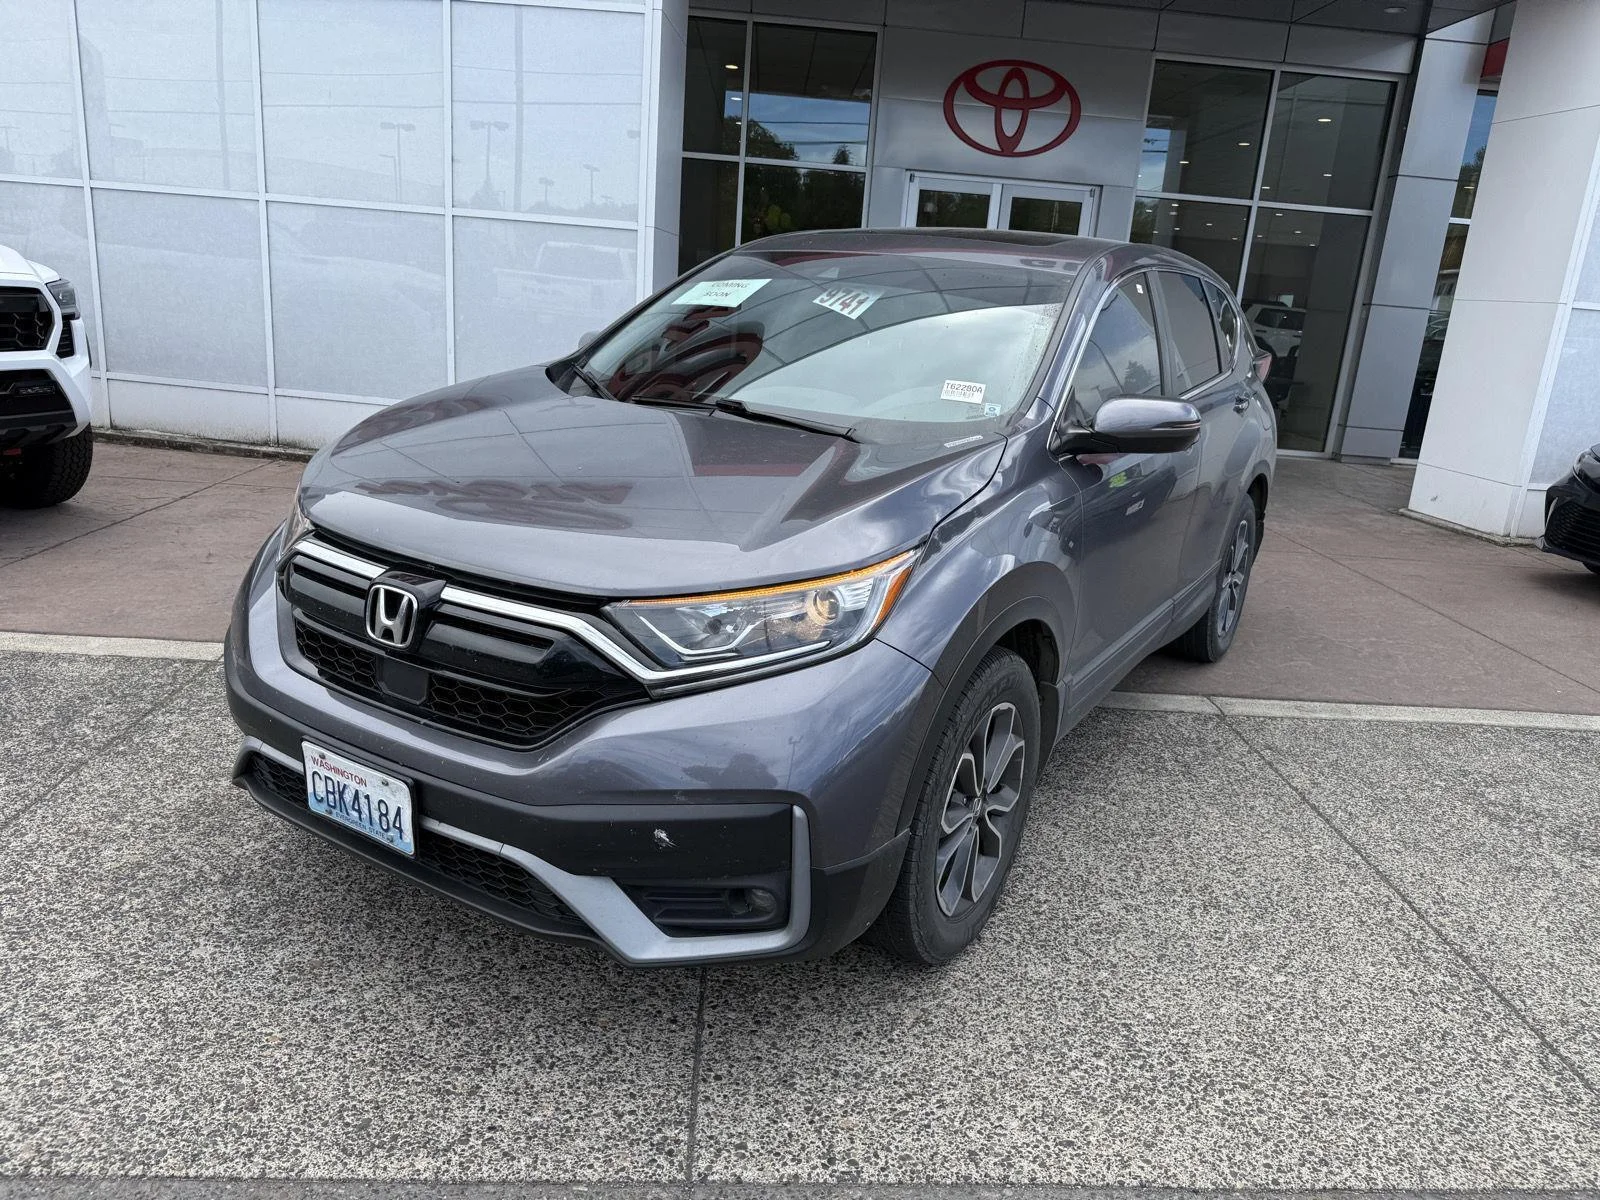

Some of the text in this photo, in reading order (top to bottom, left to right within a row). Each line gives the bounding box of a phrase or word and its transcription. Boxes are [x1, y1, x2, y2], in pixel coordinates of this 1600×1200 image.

[703, 290, 732, 298] SOON
[818, 287, 870, 315] 9741
[946, 382, 983, 394] T62280A
[310, 755, 368, 788] WASHINGTON
[311, 770, 404, 841] CBK4184
